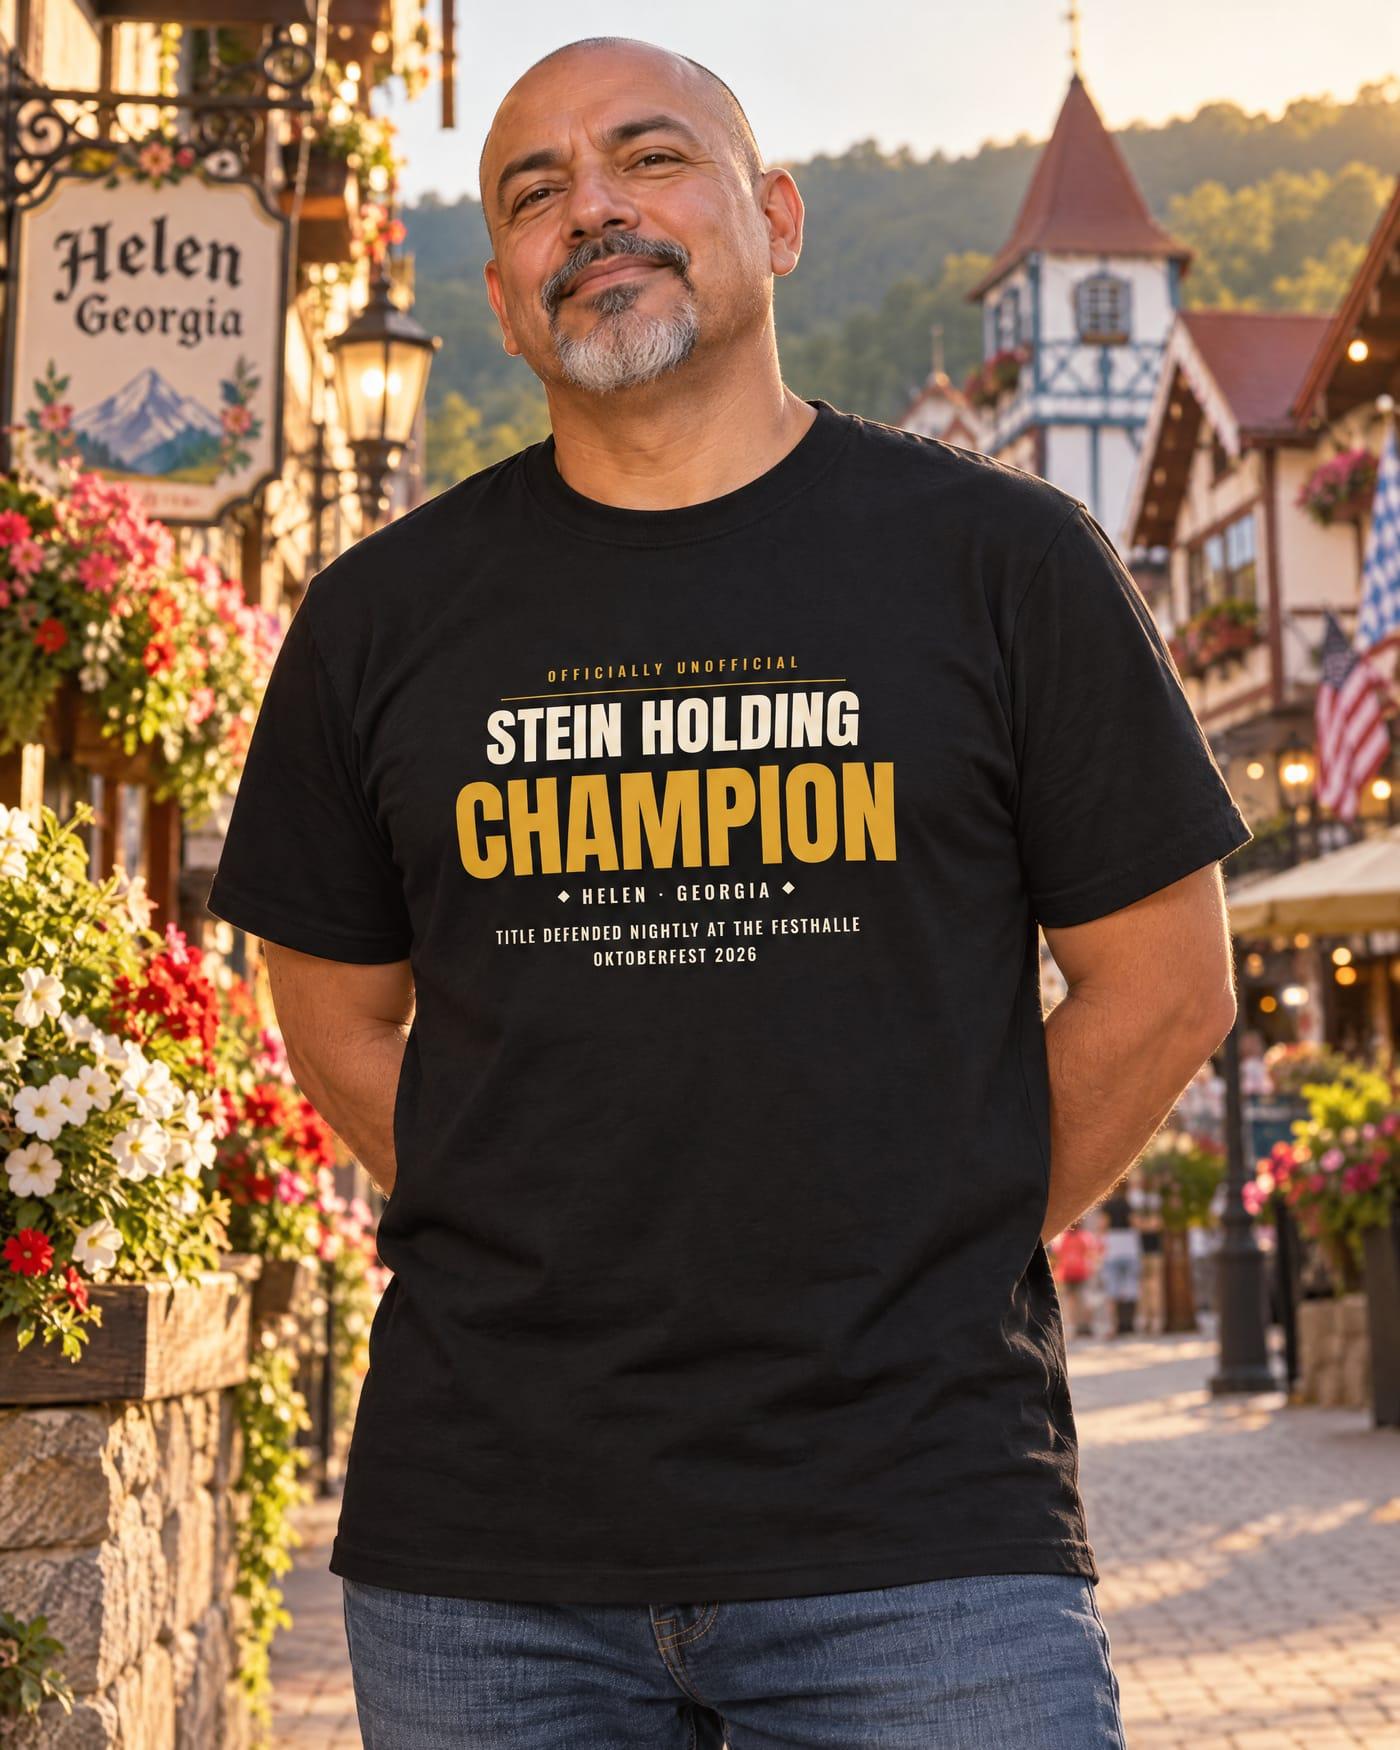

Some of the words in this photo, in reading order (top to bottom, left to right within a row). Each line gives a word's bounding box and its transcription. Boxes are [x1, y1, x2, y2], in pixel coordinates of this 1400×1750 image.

[54, 214, 243, 302] Helen
[74, 293, 243, 347] Georgia
[547, 662, 663, 683] OFFICIALLY
[677, 655, 798, 674] UNOFFICIAL
[486, 702, 622, 766] STEIN
[641, 690, 860, 756] HOLDING
[455, 761, 897, 880] CHAMPION
[582, 886, 646, 905] HELEN
[676, 881, 770, 902] GEORGIA
[495, 928, 536, 945] TITLE
[543, 925, 622, 943] DEFENDED
[630, 922, 699, 940] NIGHTLY
[707, 921, 726, 938] AT
[732, 919, 764, 937] THE
[771, 916, 861, 935] FESTHALLE
[593, 947, 707, 967] OKTOBERFEST
[714, 946, 757, 963] 2026
